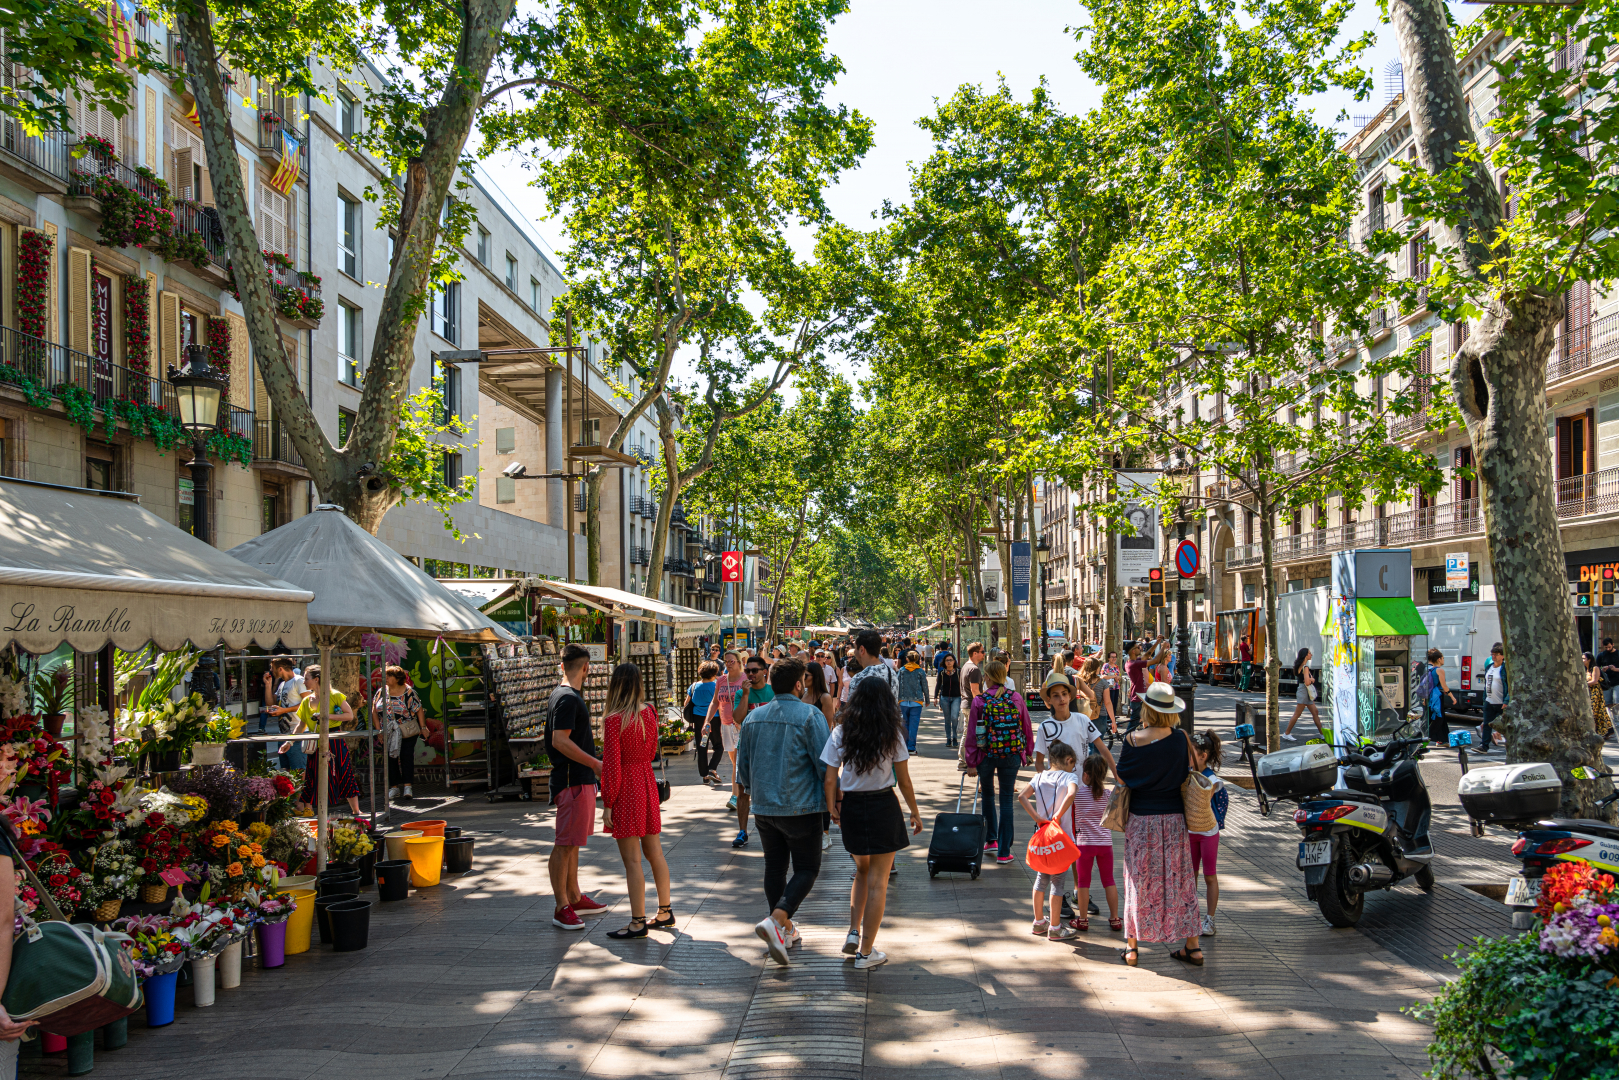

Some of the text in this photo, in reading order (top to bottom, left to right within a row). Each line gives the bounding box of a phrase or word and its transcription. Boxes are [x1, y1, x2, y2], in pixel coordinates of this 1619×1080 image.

[97, 282, 108, 370] MUSEUM
[726, 559, 733, 567] M
[1449, 560, 1455, 568] P
[3, 602, 131, 633] La Rambla
[208, 617, 294, 634] Tel. 93 302 50 22
[1305, 841, 1329, 854] 1747
[1305, 853, 1322, 864] HNF
